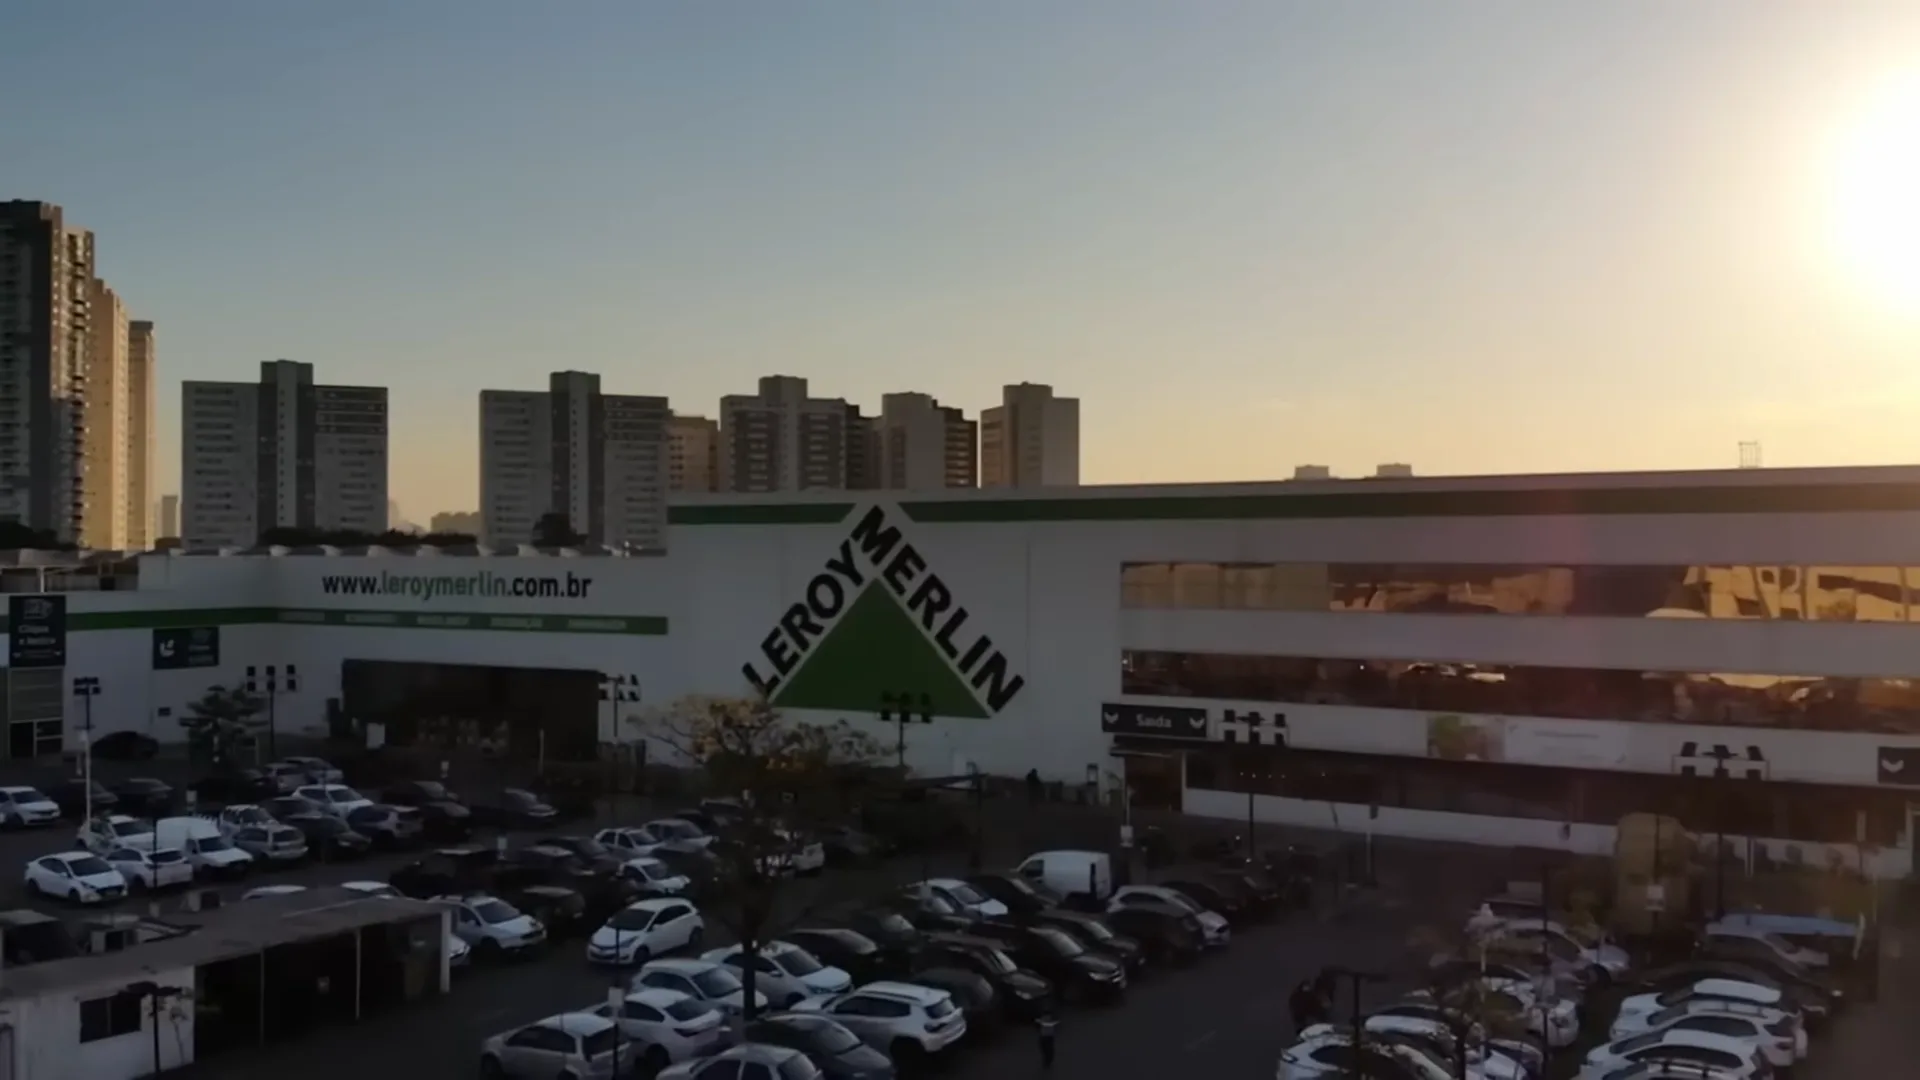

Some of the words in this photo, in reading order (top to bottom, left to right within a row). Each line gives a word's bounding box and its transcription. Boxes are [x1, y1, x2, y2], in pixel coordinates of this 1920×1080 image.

[322, 571, 592, 601] www.leroymerlin.com.br
[742, 538, 864, 699] LEROY
[851, 505, 1024, 713] MERLIN
